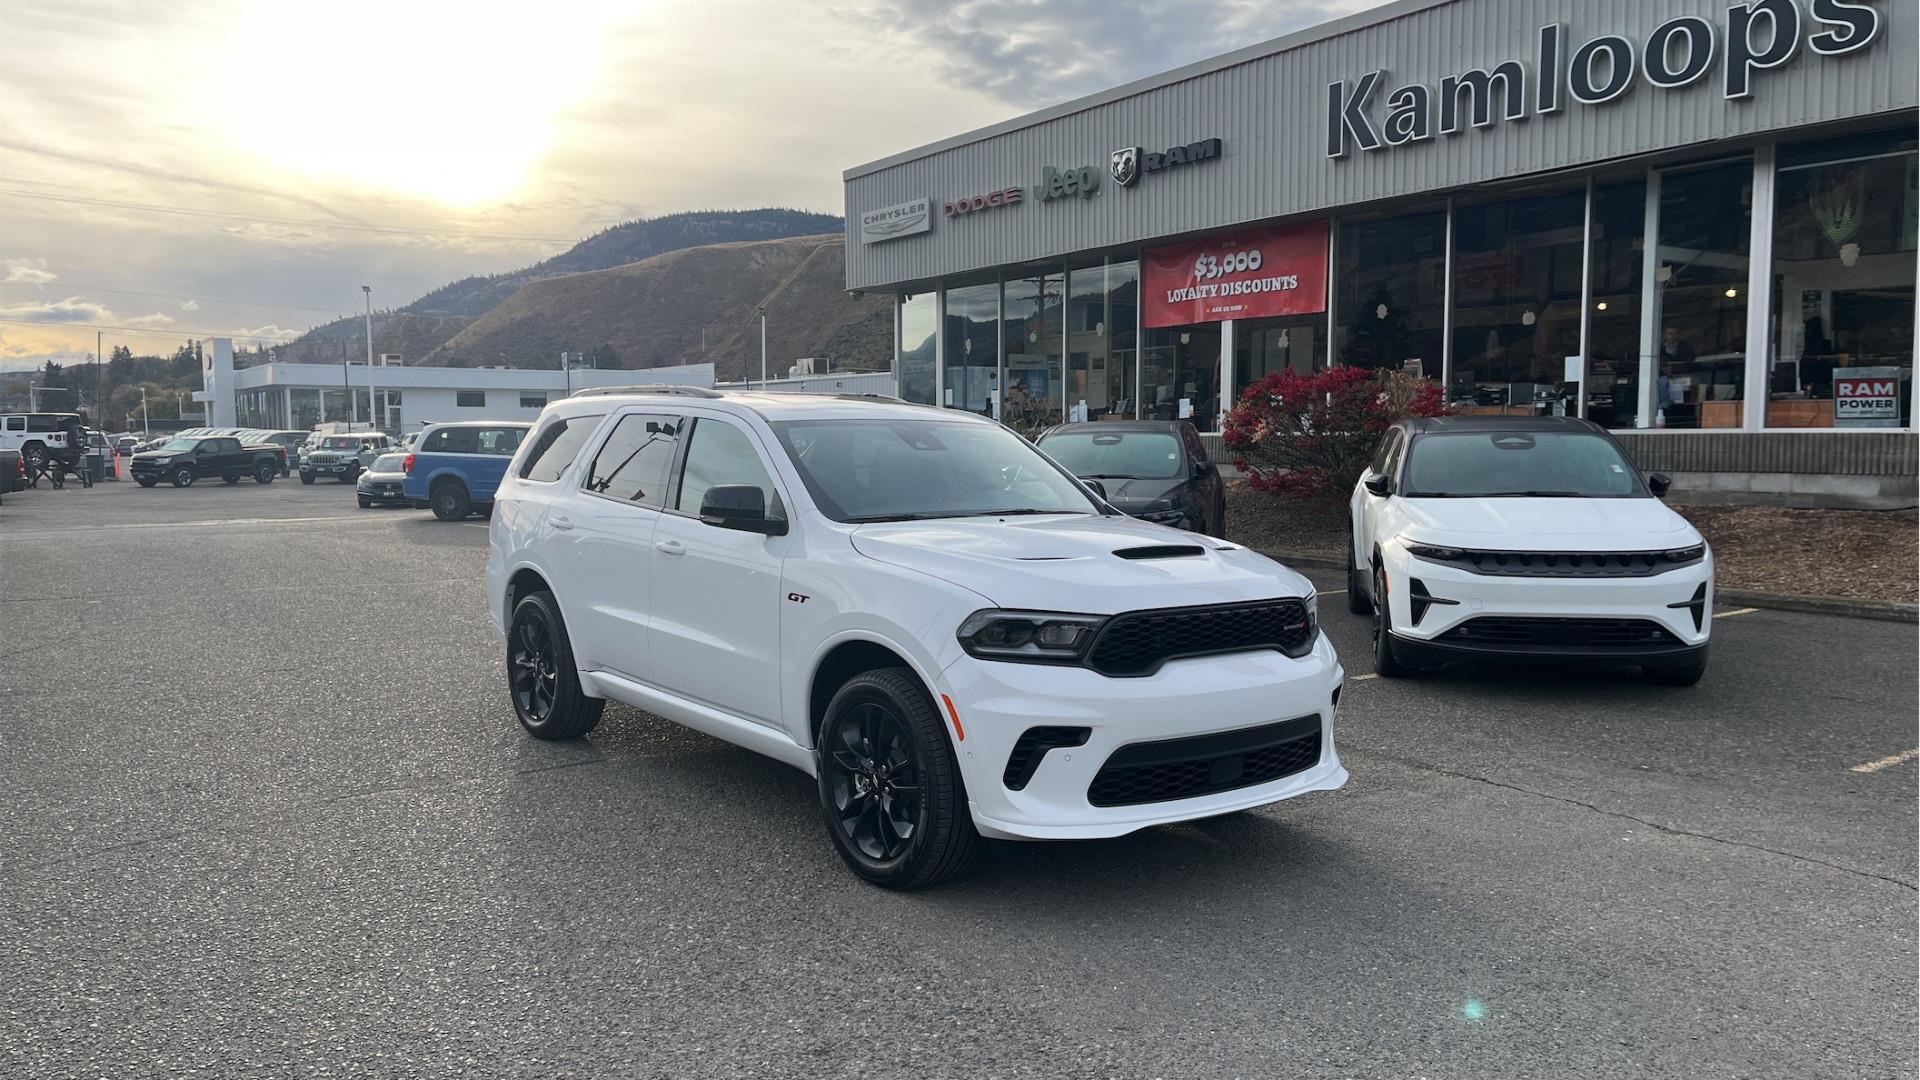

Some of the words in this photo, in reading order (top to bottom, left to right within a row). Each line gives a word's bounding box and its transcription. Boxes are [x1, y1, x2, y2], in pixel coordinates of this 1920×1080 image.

[1327, 0, 1880, 158] Kamloops
[1143, 138, 1221, 172] RAM
[1034, 165, 1098, 200] Jeep
[863, 203, 926, 225] CHRYSLER
[943, 186, 1024, 218] DODGE
[1195, 250, 1262, 282] $3,000
[1167, 283, 1219, 303] LOYALTY
[1220, 275, 1298, 297] DISCOUNTS
[1839, 382, 1894, 396] RAM
[1840, 400, 1894, 408] POWER
[788, 592, 811, 604] GT
